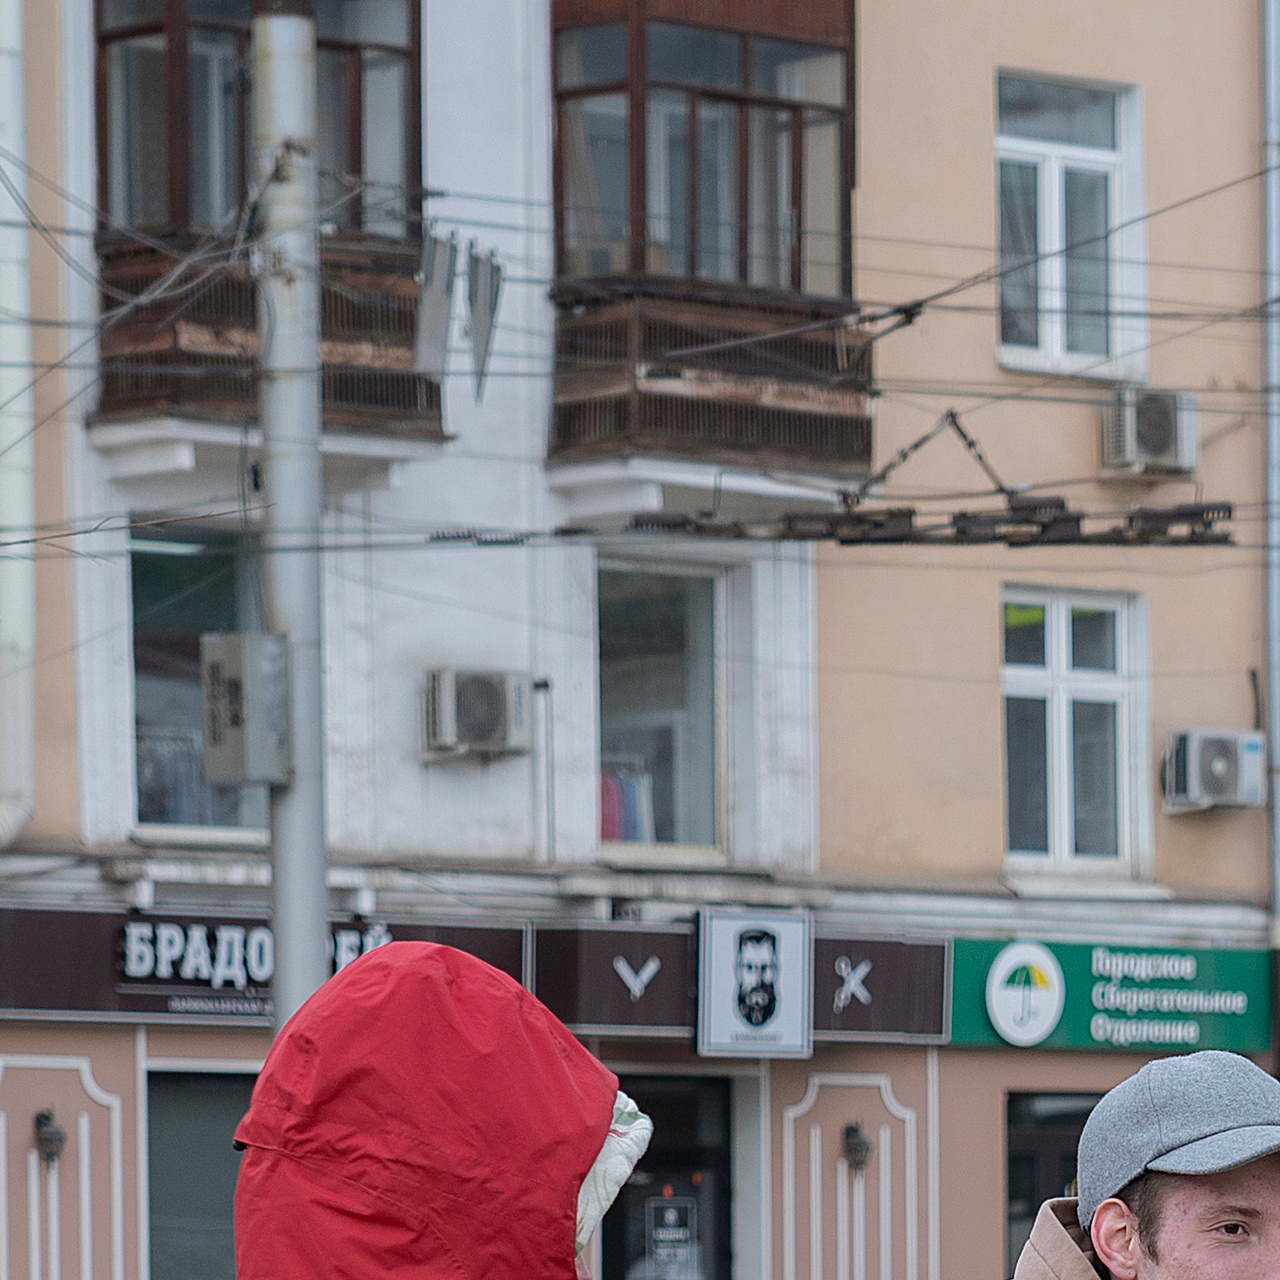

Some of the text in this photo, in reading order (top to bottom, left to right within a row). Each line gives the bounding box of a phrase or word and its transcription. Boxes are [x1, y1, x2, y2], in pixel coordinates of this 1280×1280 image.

[1092, 947, 1197, 982] Городское
[1091, 980, 1248, 1016] Сберегательное
[1090, 1012, 1200, 1047] Отделение
